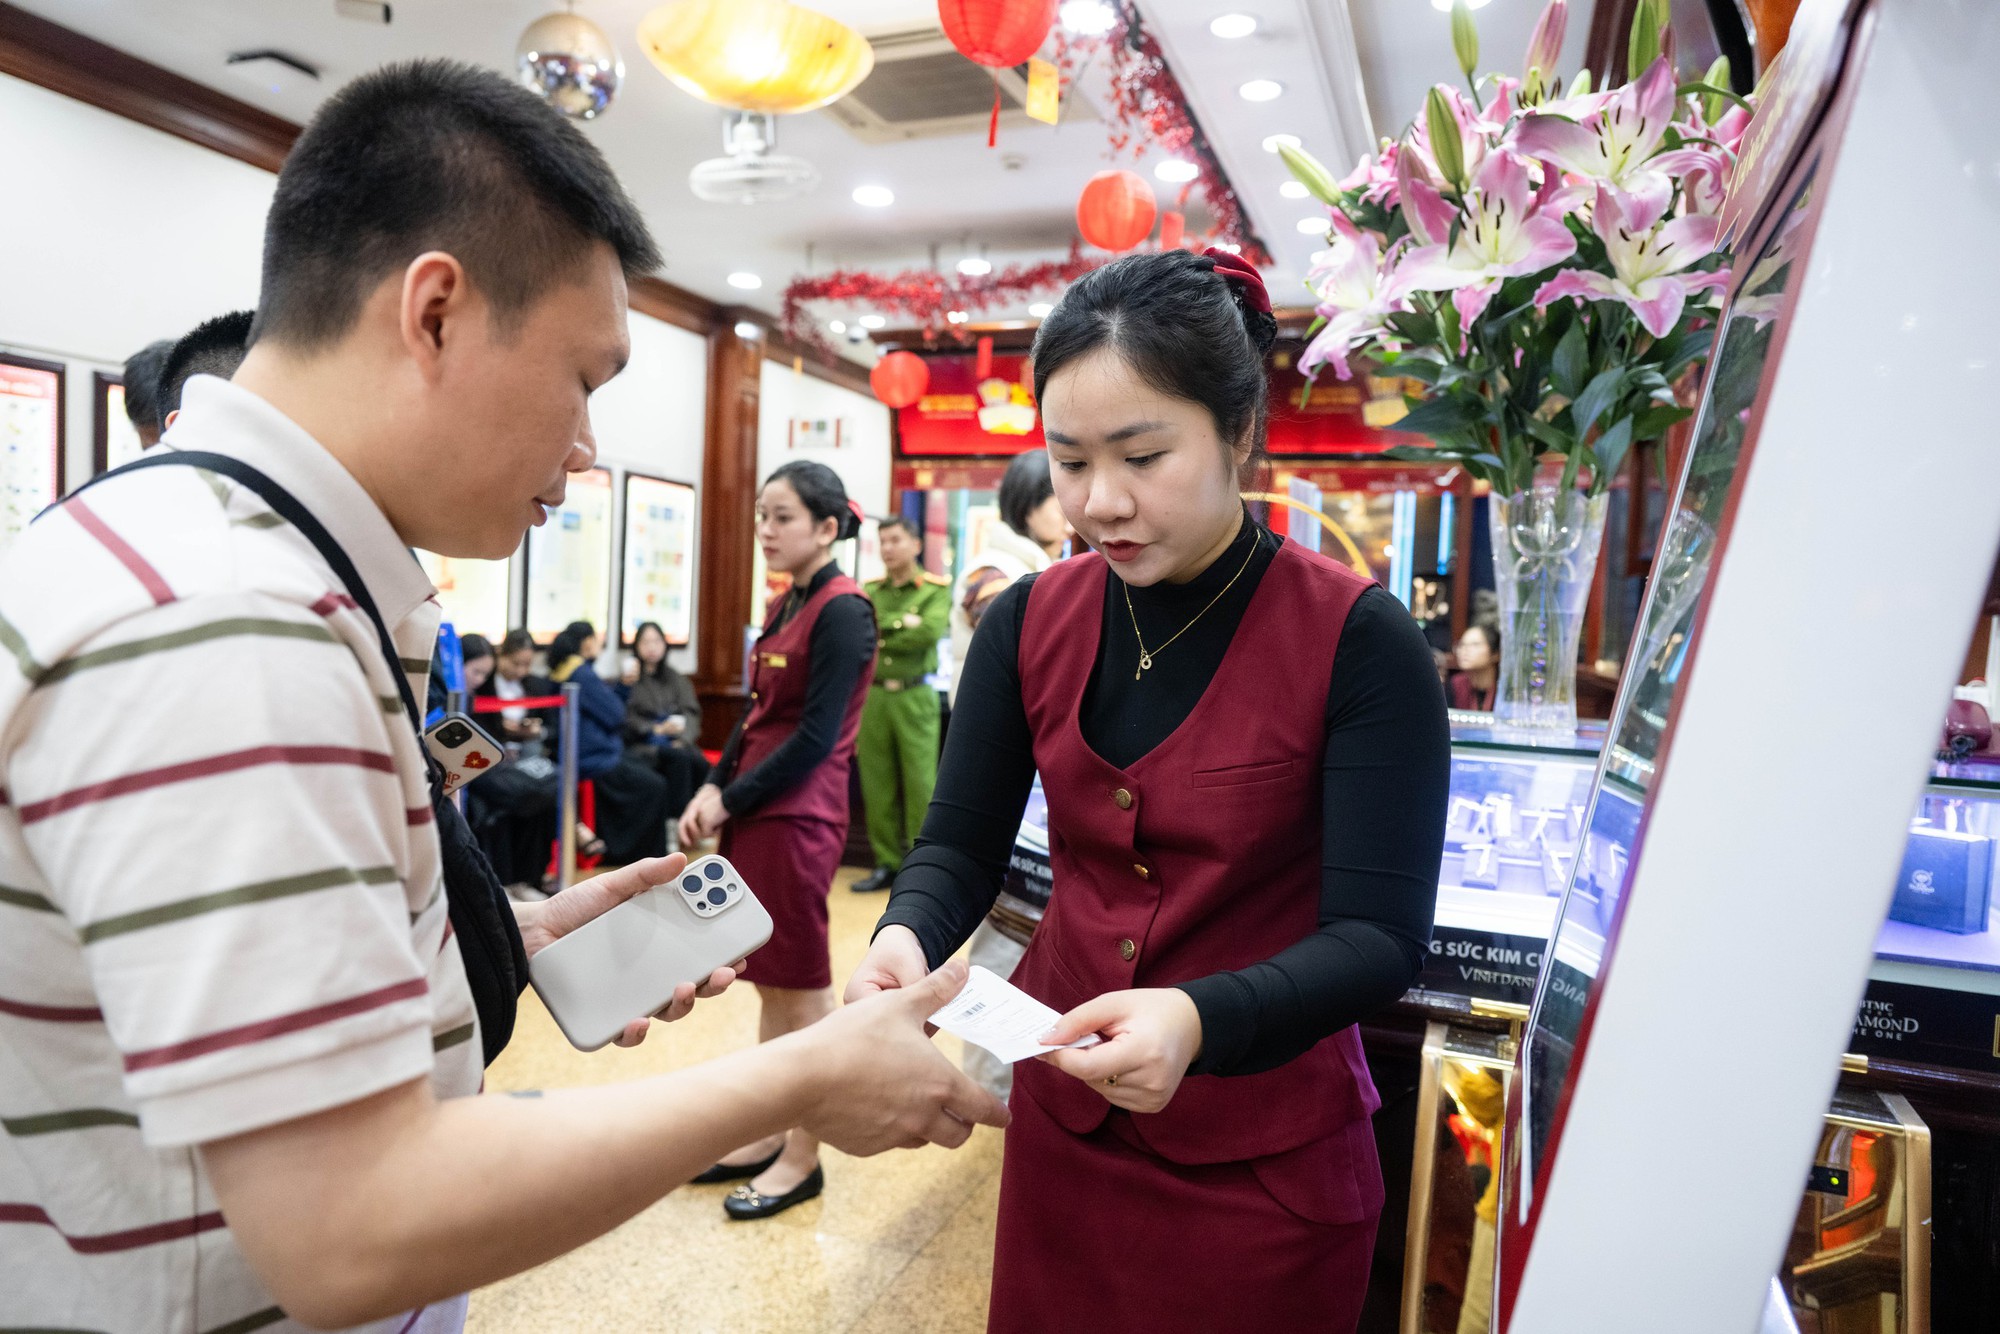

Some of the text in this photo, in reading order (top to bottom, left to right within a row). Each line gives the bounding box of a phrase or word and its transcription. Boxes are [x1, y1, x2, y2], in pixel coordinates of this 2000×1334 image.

[1446, 940, 1483, 960] SỨC
[1487, 947, 1521, 965] KIM
[1875, 1029, 1902, 1041] ONE
